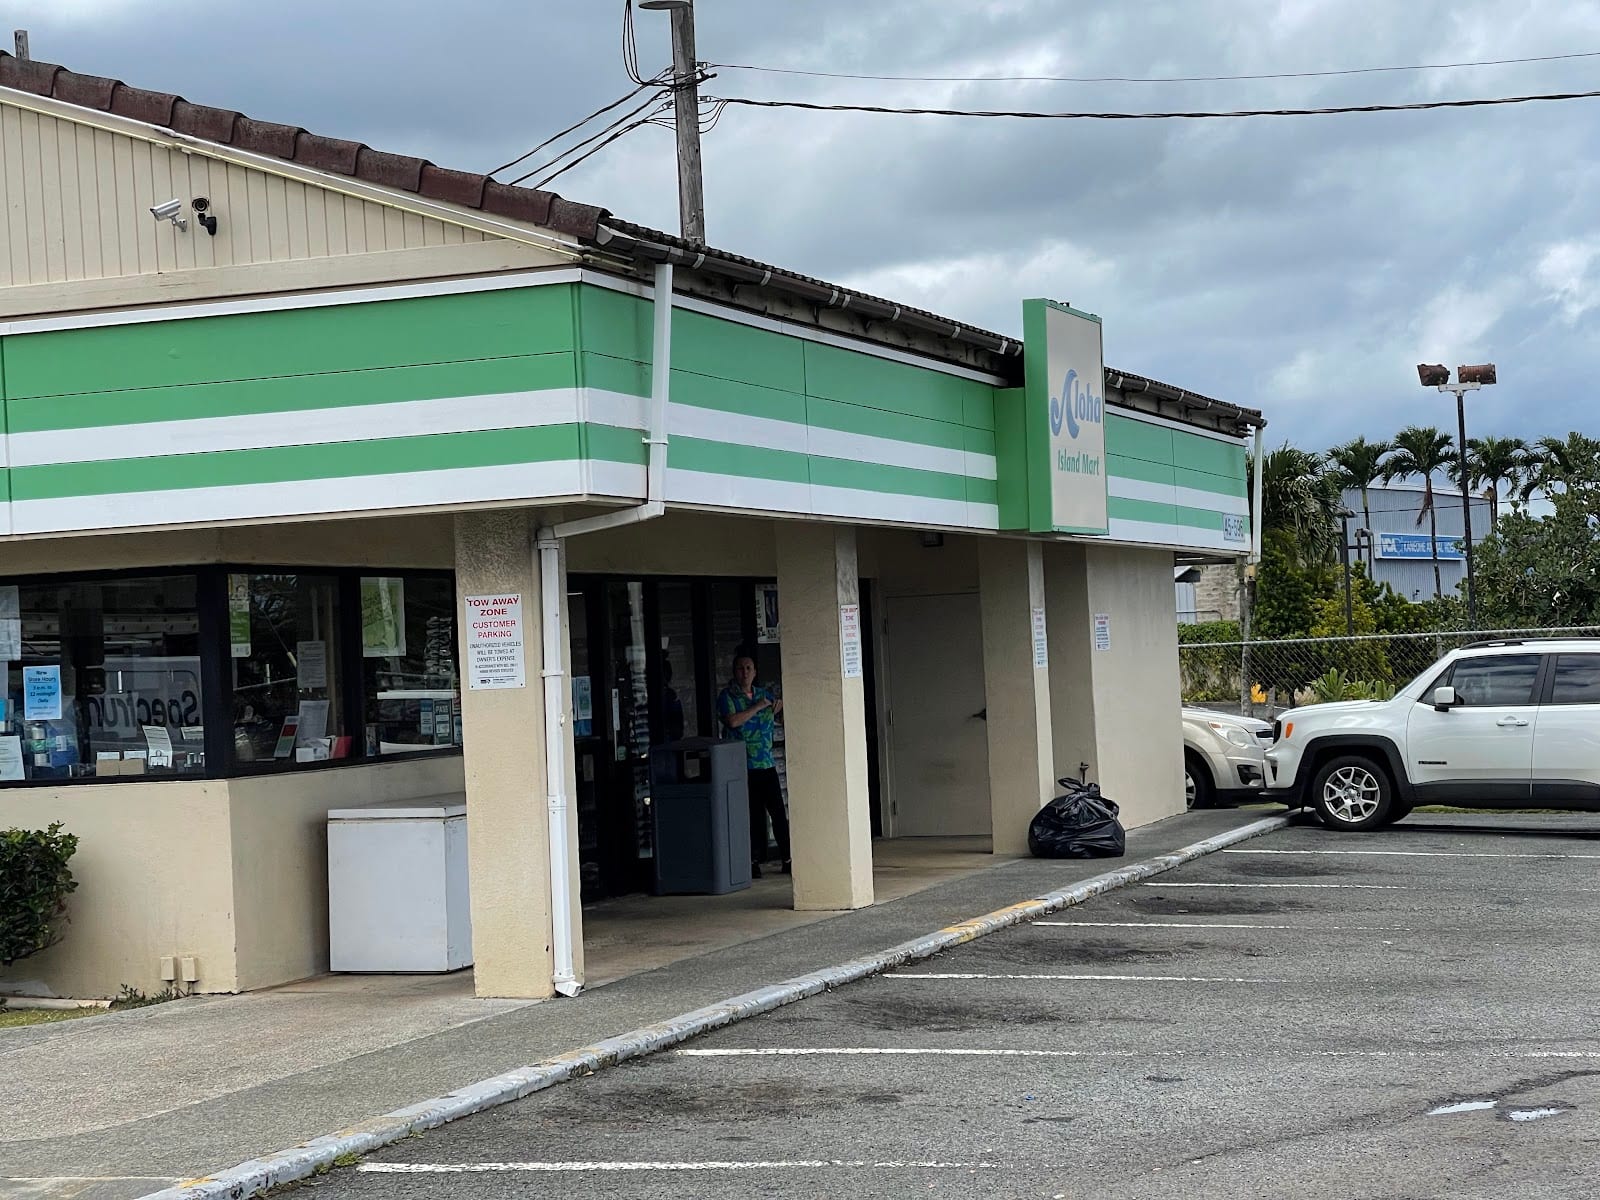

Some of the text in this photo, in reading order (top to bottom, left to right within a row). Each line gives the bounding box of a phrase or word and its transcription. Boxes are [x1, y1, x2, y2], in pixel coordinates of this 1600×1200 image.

[1050, 369, 1101, 439] Aloha
[1057, 448, 1100, 476] Island Mart
[468, 597, 519, 607] TOW AWAY
[480, 608, 508, 617] ZONE
[472, 620, 516, 629] CUSTOMER
[478, 630, 512, 638] PARKING
